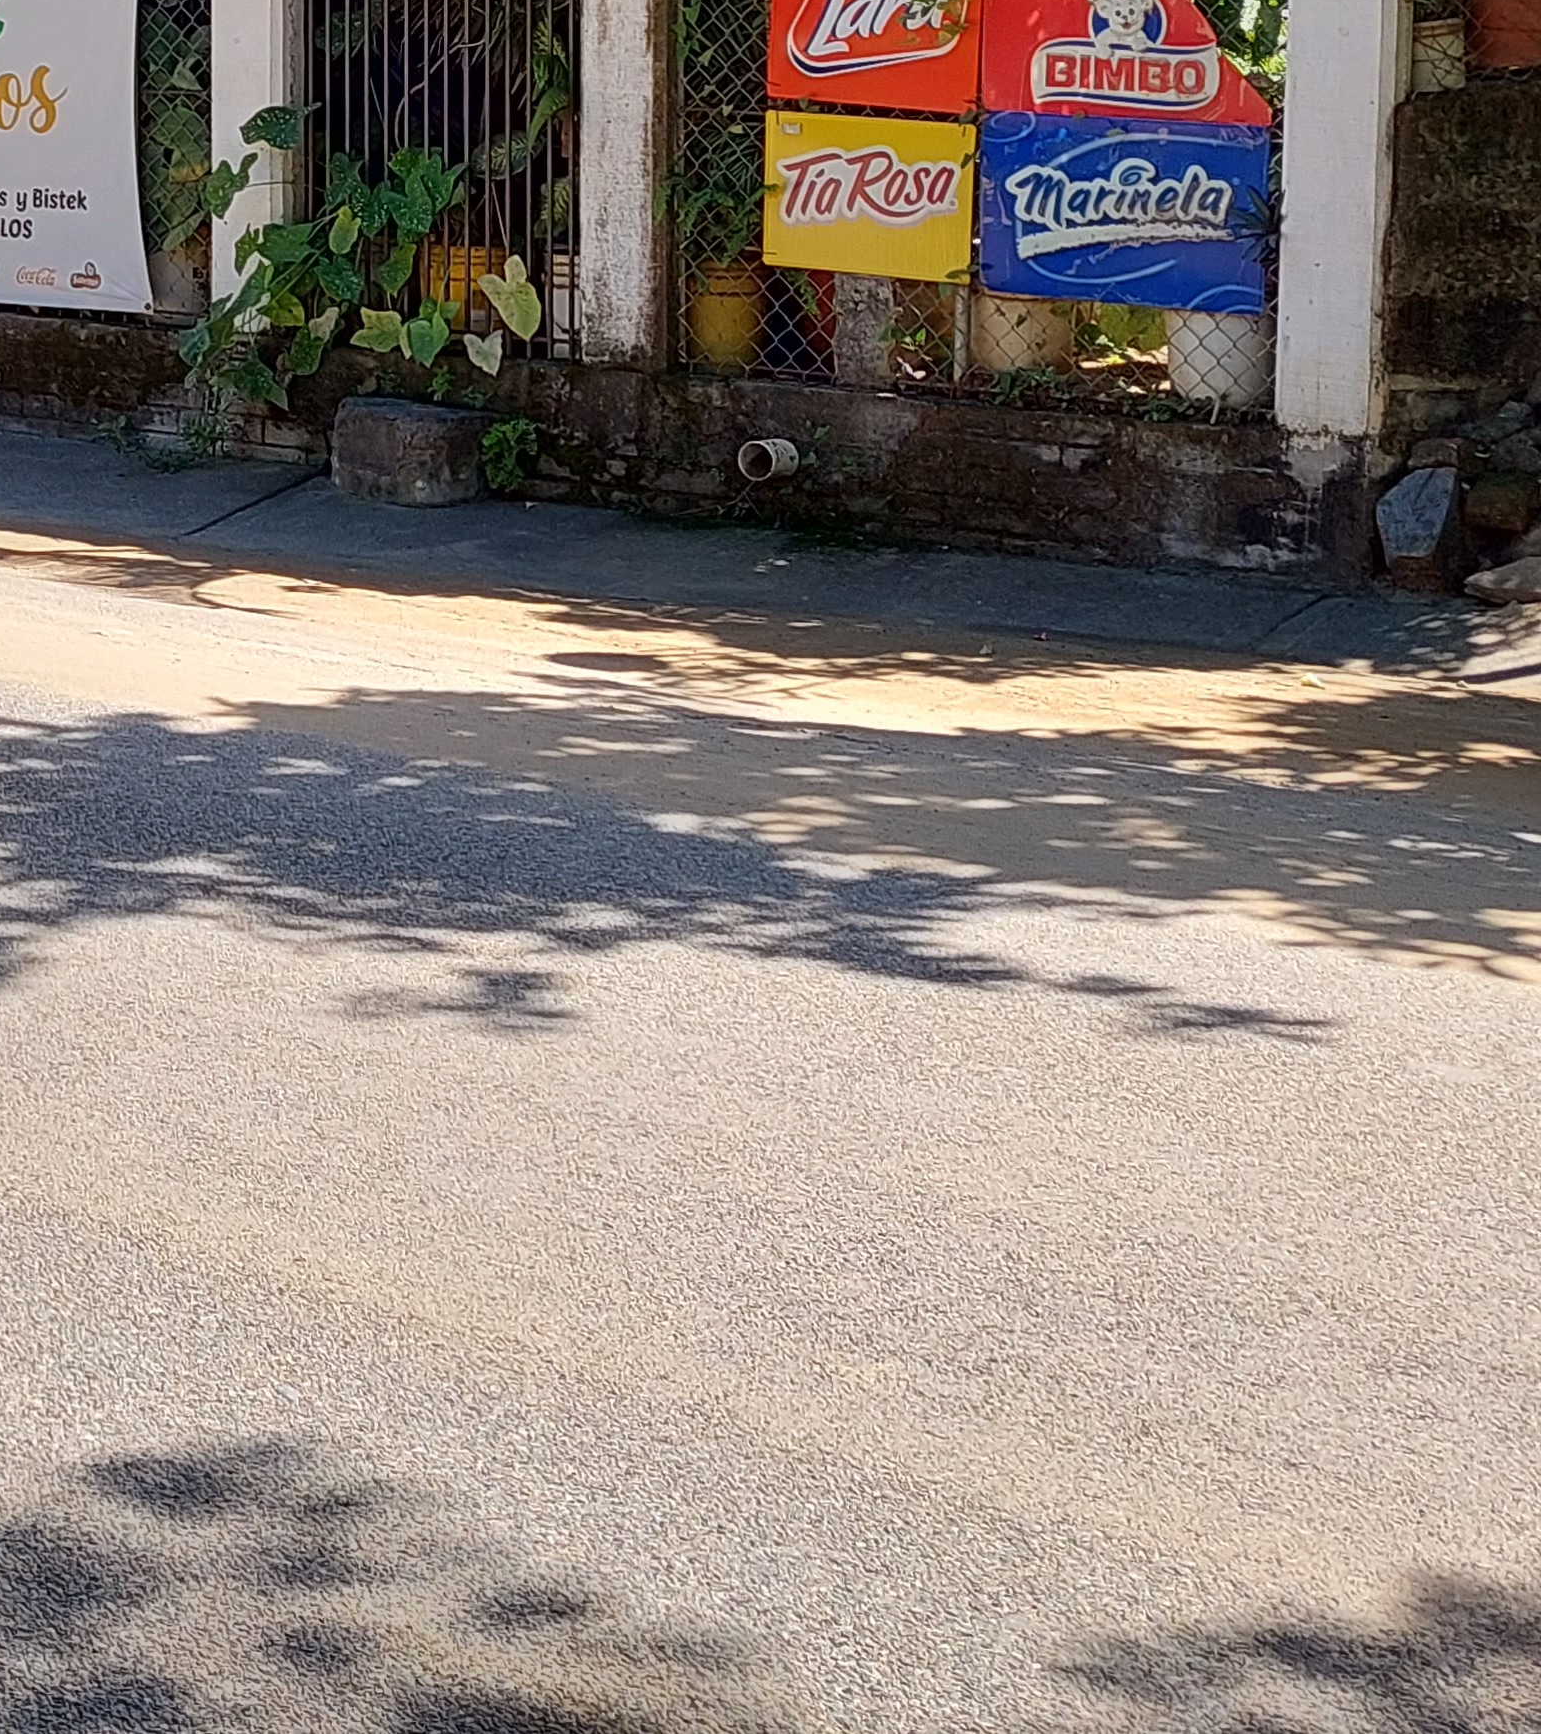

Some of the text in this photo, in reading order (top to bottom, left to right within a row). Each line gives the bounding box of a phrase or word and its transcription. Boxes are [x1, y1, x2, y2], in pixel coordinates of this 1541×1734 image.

[1045, 52, 1206, 95] BIMBO
[16, 192, 28, 212] y
[32, 188, 88, 211] Bistek
[843, 151, 956, 219] Rosa
[1014, 164, 1225, 229] Marinela
